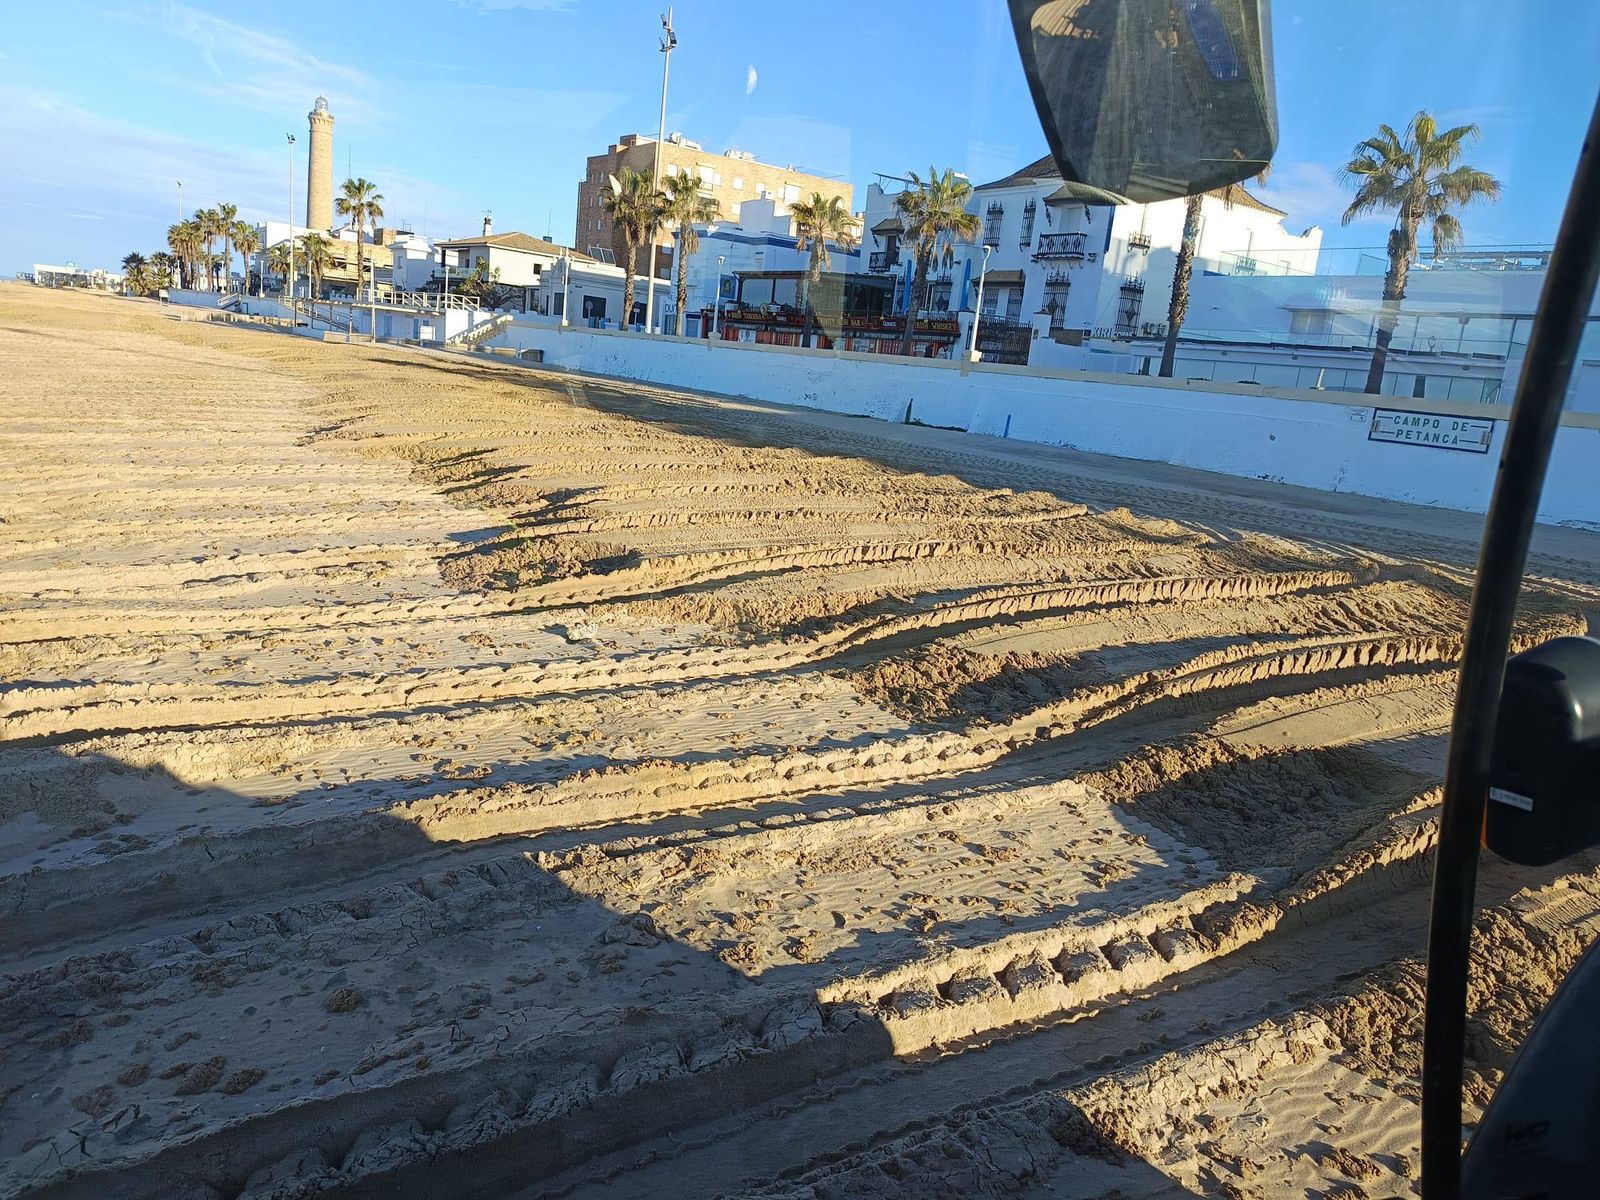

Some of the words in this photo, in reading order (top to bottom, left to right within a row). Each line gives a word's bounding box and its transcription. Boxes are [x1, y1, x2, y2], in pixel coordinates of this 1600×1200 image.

[1393, 415, 1440, 429] CAMPO
[1451, 420, 1470, 432] DE
[1395, 428, 1458, 446] PETANCA
